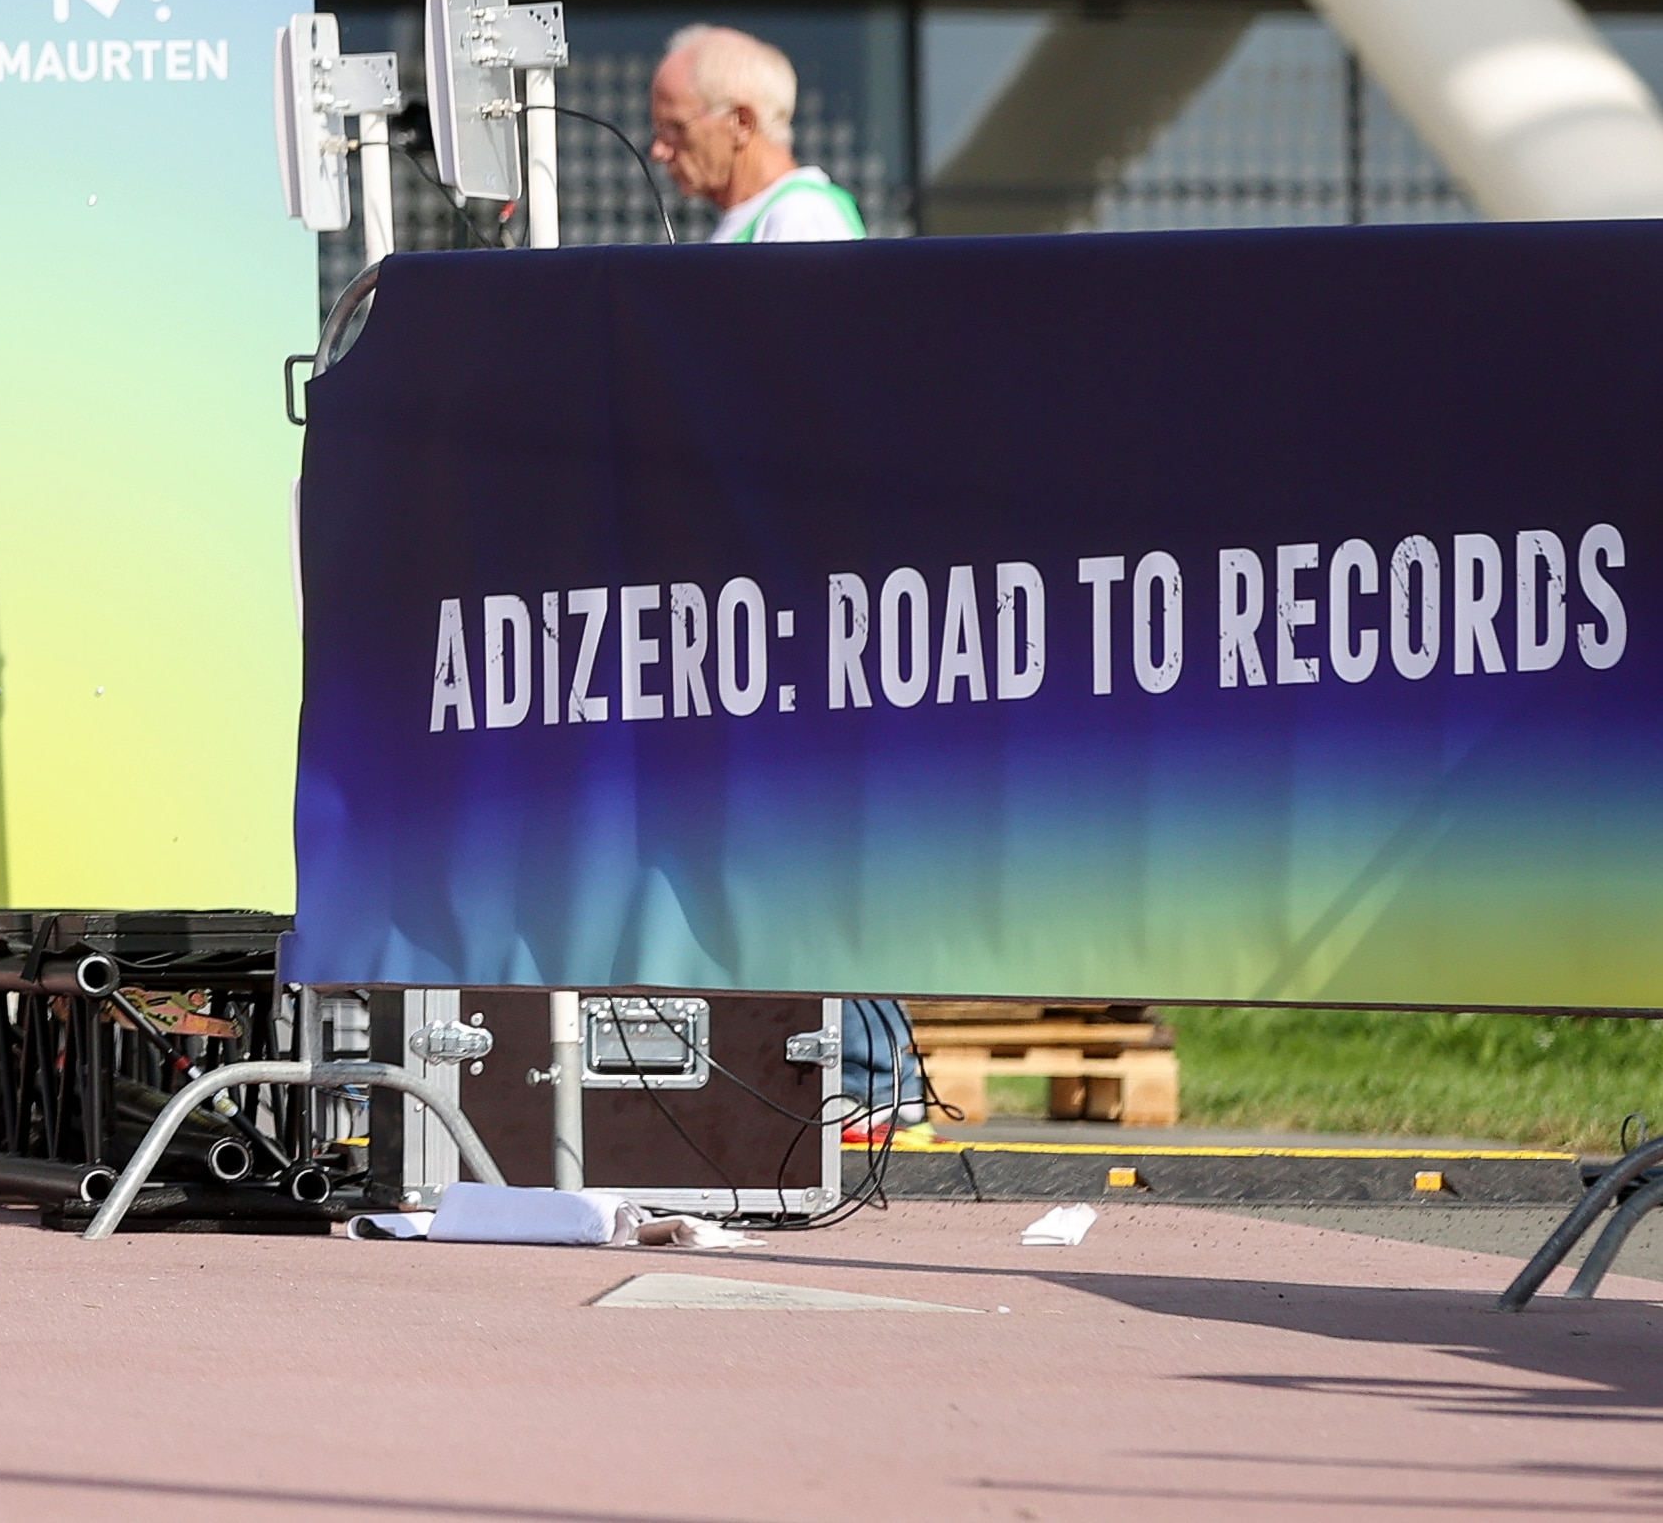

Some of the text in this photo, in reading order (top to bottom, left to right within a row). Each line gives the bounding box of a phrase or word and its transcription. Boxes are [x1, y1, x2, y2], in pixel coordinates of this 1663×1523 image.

[429, 522, 1628, 733] ADIZERO: ROAD TO RECORDS
